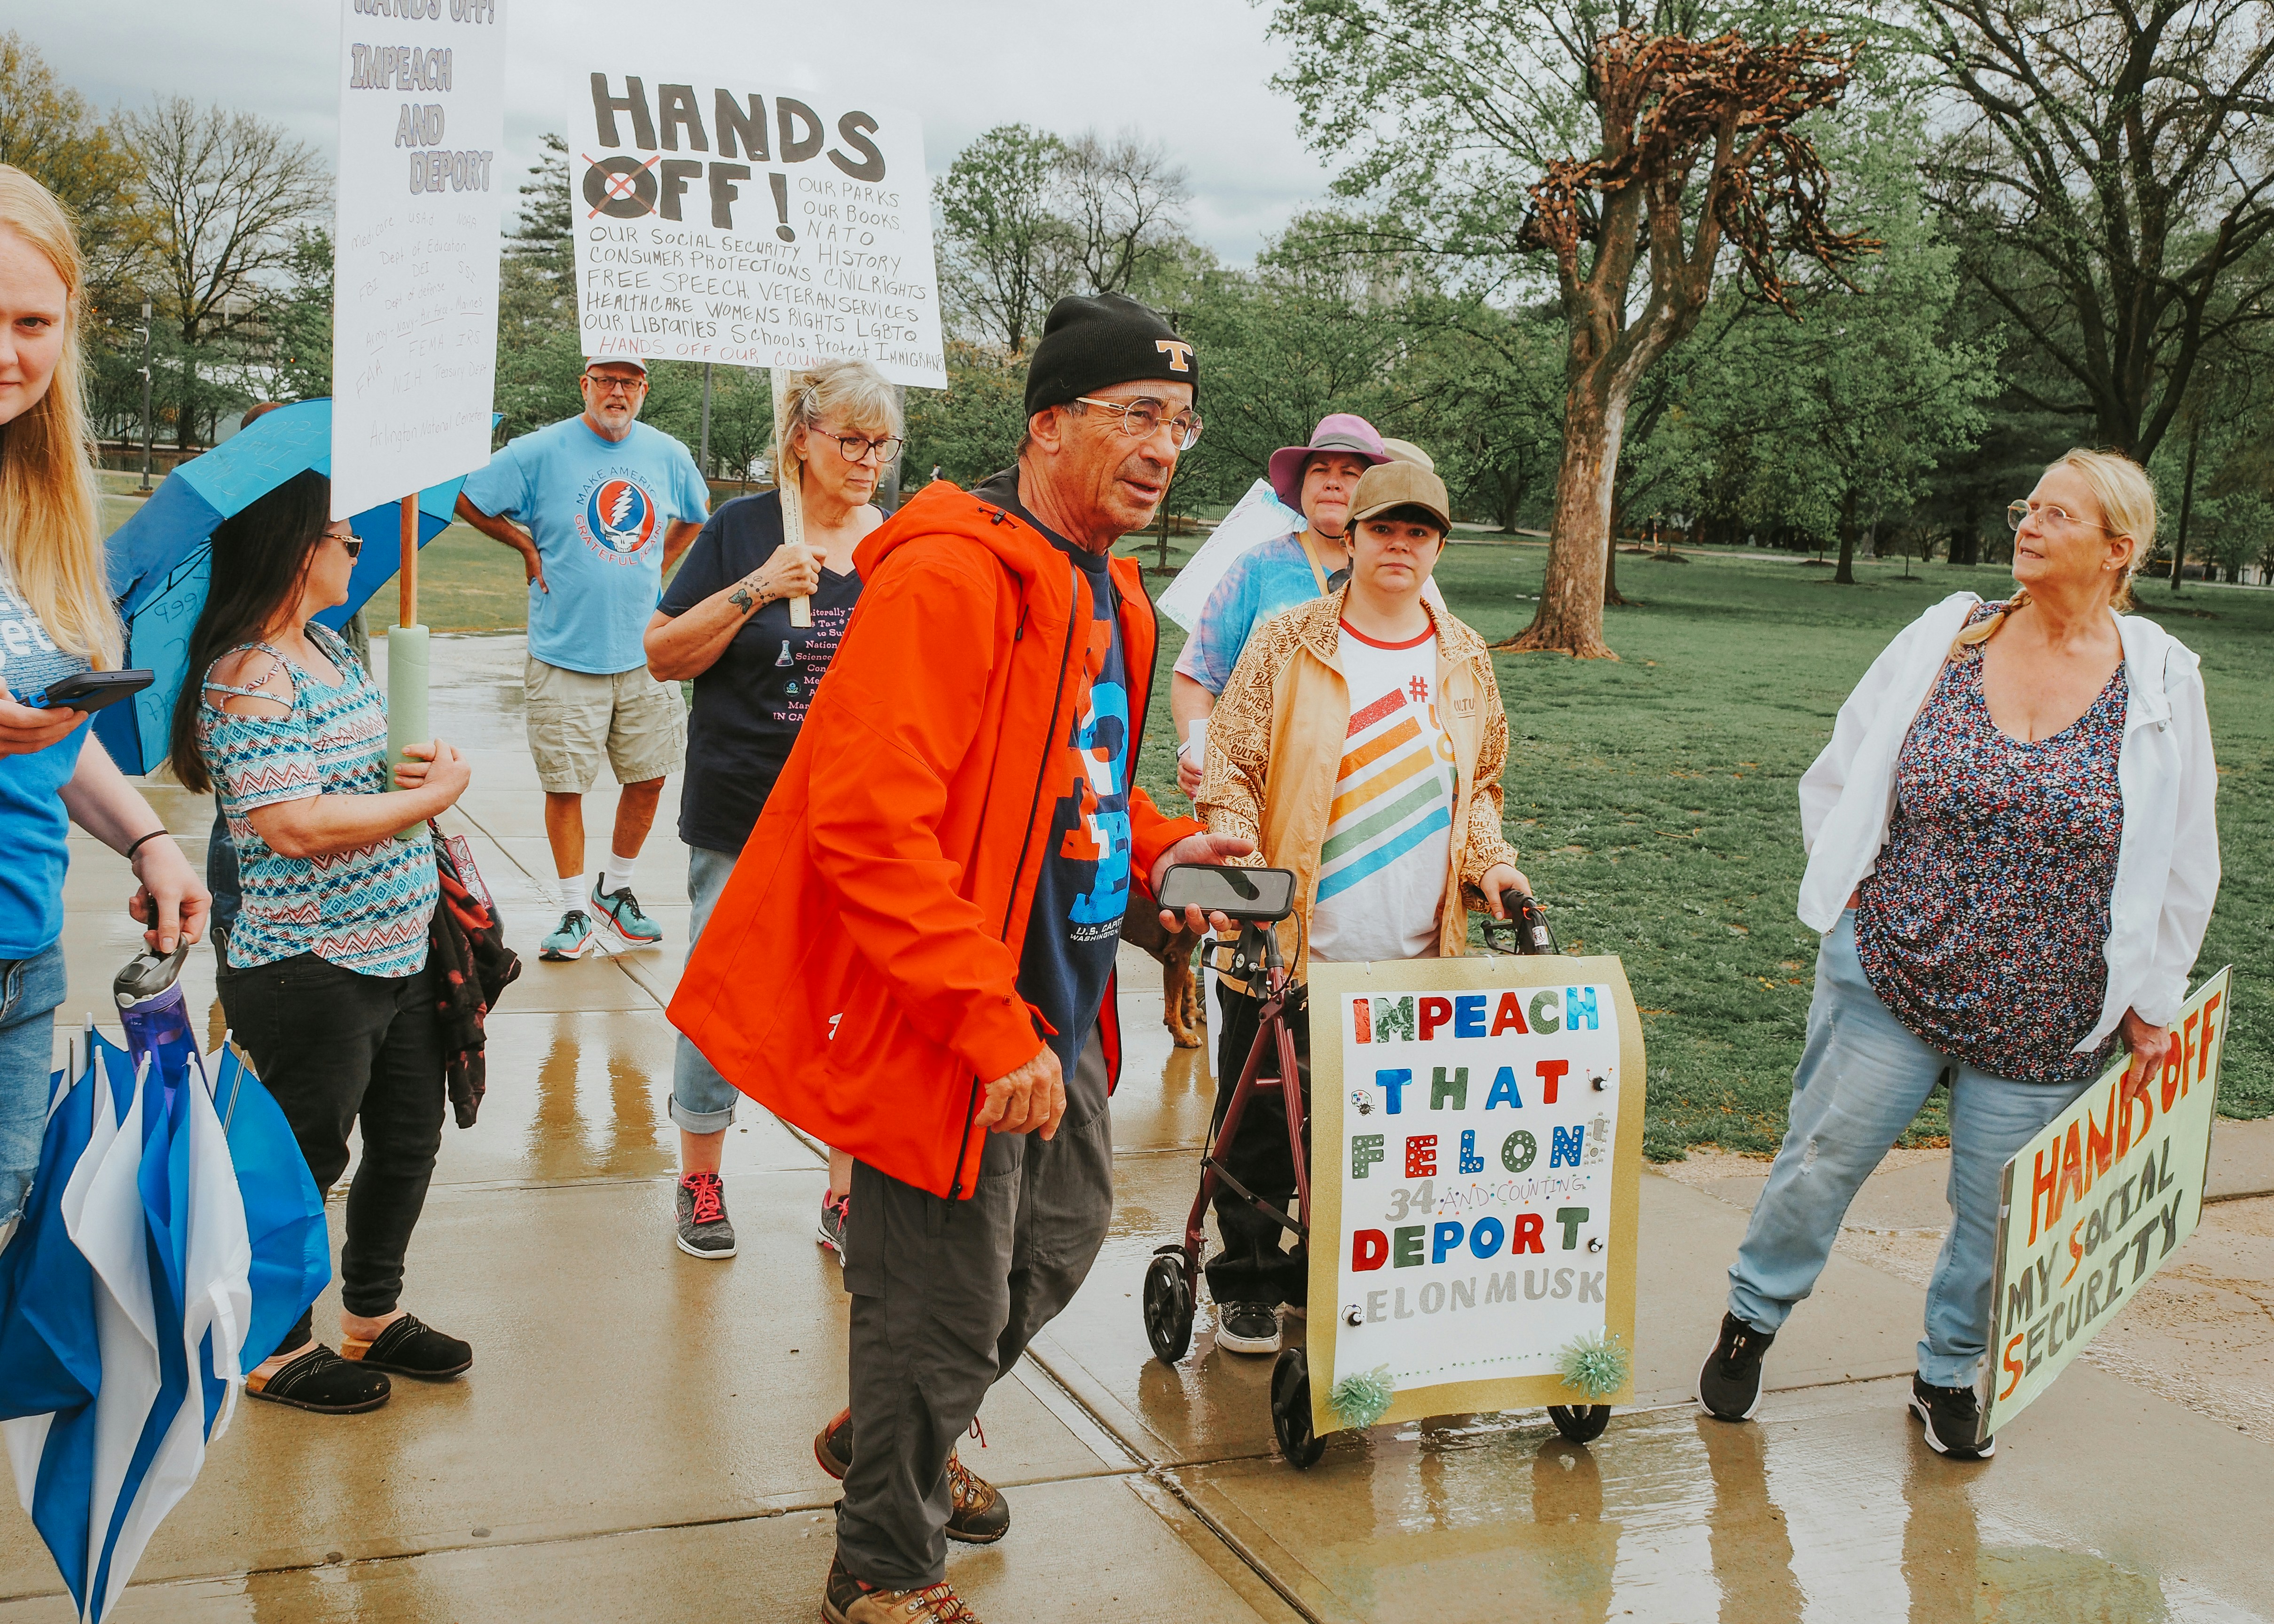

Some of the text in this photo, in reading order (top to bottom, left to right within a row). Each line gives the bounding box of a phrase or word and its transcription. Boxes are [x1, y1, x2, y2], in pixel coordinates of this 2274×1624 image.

[351, 43, 452, 92] IMPEACH
[395, 103, 445, 148] AND
[590, 72, 886, 183] HANDS
[410, 150, 493, 195] DEPORT
[799, 177, 836, 197] OUR
[583, 155, 796, 243] OFF!
[803, 201, 839, 219] OUR
[352, 217, 394, 250] Medicare
[456, 212, 477, 229] NOAA
[412, 241, 421, 256] of
[427, 238, 467, 253] Education
[590, 226, 638, 243] OUR
[807, 219, 874, 246] NATO
[412, 261, 476, 284] DEI SSI
[590, 246, 684, 267] CONSUMER
[359, 278, 379, 303] FBI
[408, 287, 415, 301] of
[588, 268, 651, 288] FREE
[455, 296, 482, 310] Marines
[584, 313, 624, 331] OUR
[816, 333, 870, 359] Protect
[705, 301, 780, 324] WOMENS
[857, 318, 918, 343] LGBTQ
[409, 329, 481, 359] FEMA IRS
[599, 336, 665, 354] HANDS
[676, 343, 712, 356] OFF
[720, 346, 758, 363] OUR
[1155, 340, 1193, 372] T
[433, 364, 465, 380] Treasury
[370, 420, 417, 453] Arlington
[420, 415, 452, 437] National
[575, 466, 660, 508] MAKE AMERICA
[574, 514, 663, 566] GRATEFUL AGAIN!
[811, 608, 845, 617] iterally
[1229, 736, 1249, 745] LOVE
[1211, 794, 1235, 803] BEAUTY
[1076, 927, 1098, 936] U.S.
[1353, 986, 1599, 1044] IMPEACH
[2161, 990, 2221, 1114] OFF
[1376, 1059, 1569, 1115] THAT
[1385, 1179, 1436, 1222] 34
[1441, 1186, 1490, 1212] AND
[1351, 1207, 1590, 1272] DEPORT
[2005, 1134, 2175, 1336] MY SOCIAL
[1366, 1268, 1605, 1323] ELON MUSK
[1999, 1188, 2183, 1402] SECURITY
